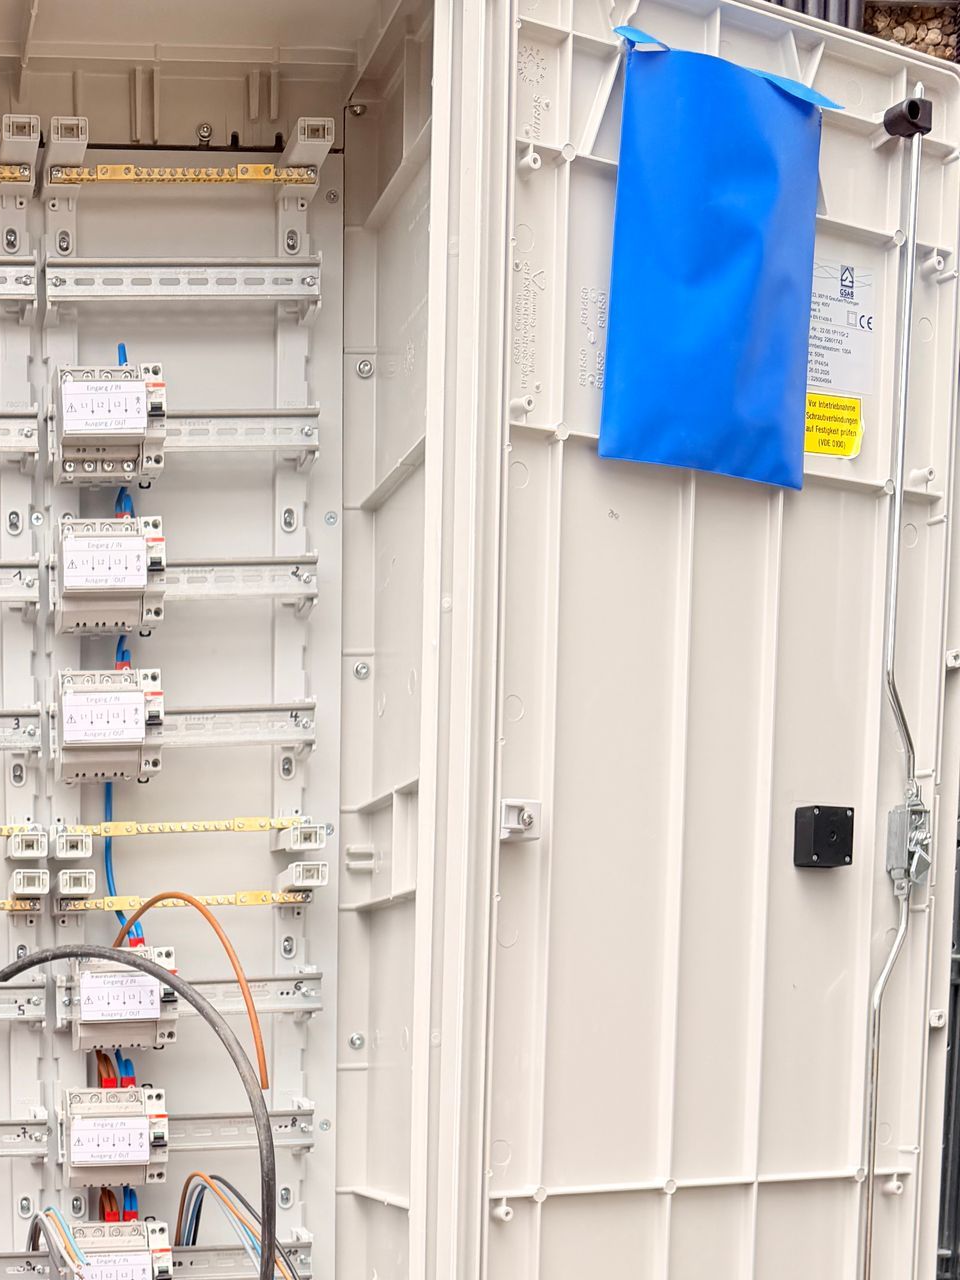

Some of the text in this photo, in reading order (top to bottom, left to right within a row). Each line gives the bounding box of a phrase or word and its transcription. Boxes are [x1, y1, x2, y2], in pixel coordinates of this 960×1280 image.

[840, 288, 854, 298] GSAB
[808, 399, 816, 407] Vor
[290, 710, 299, 722] 4
[13, 717, 20, 730] 3
[294, 980, 303, 991] 6
[18, 1004, 25, 1016] 5
[291, 1116, 298, 1127] 8
[20, 1126, 28, 1139] 7
